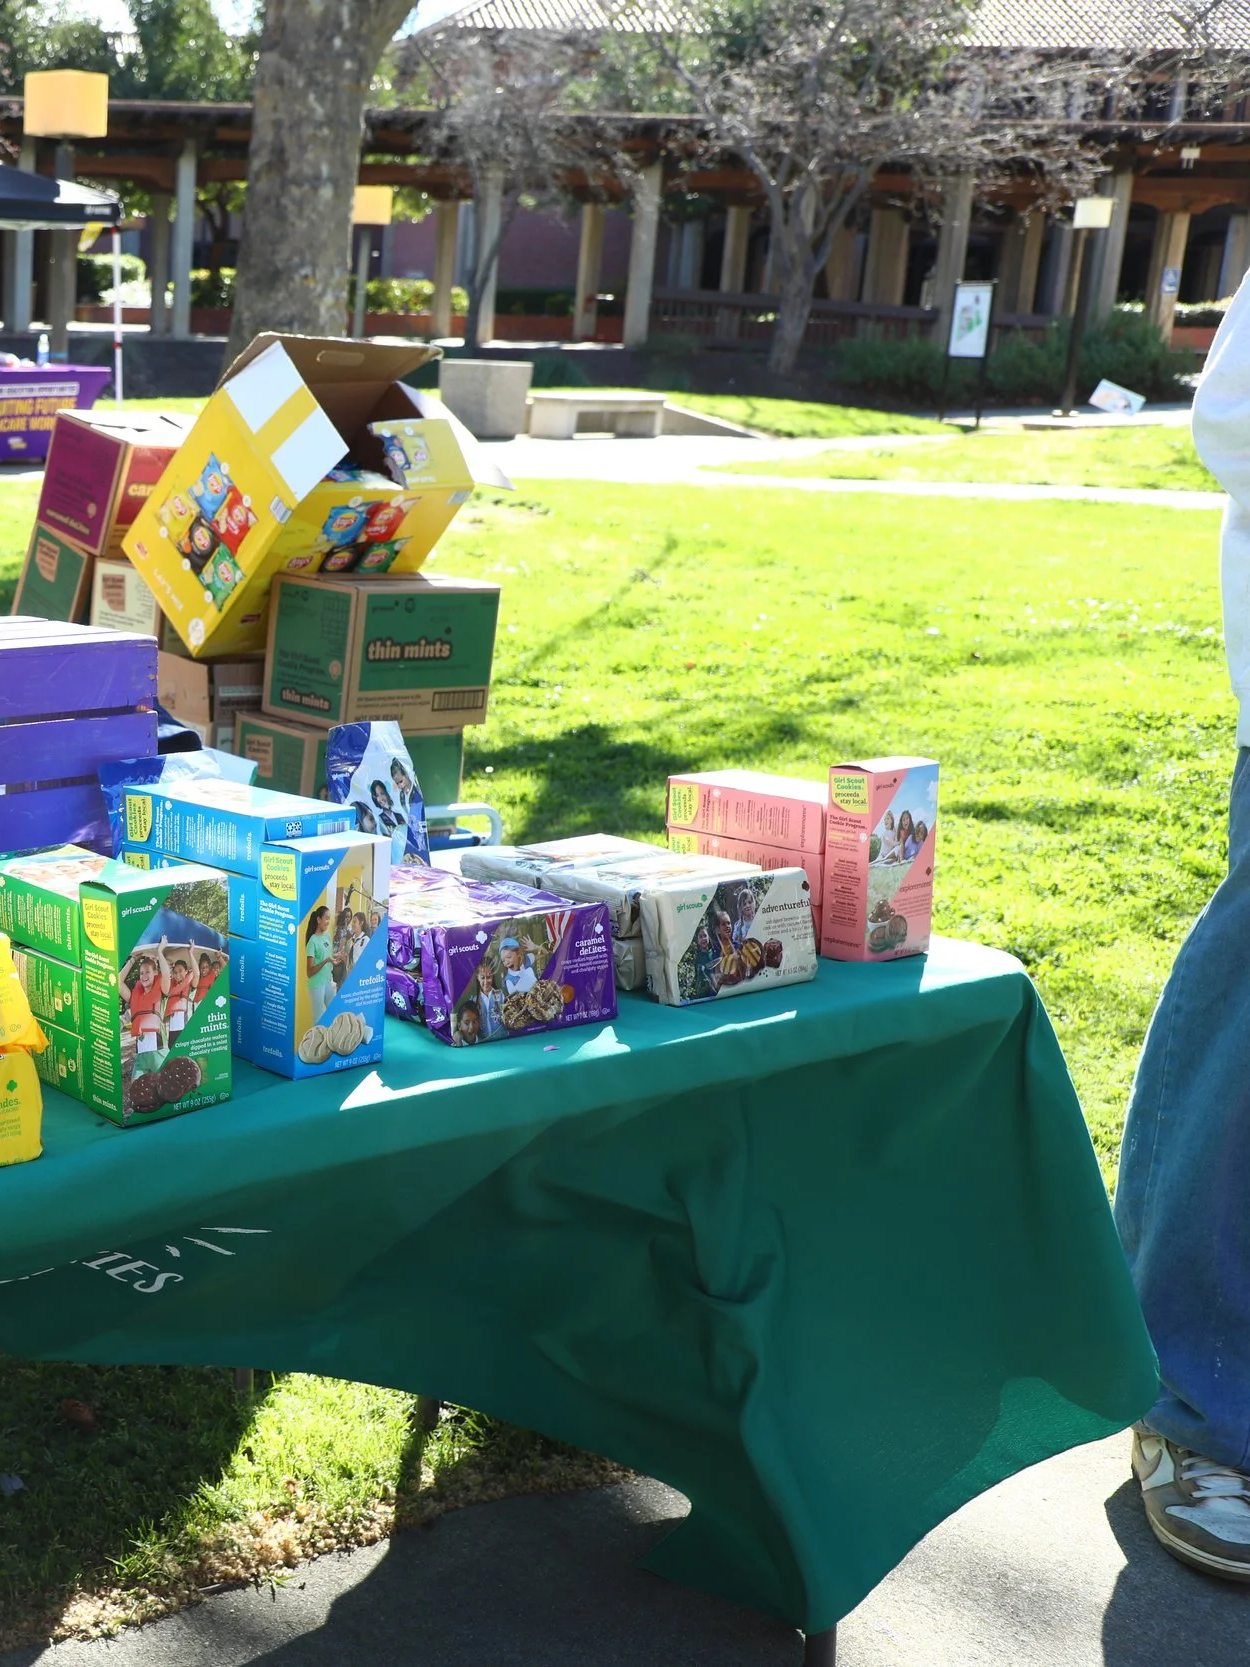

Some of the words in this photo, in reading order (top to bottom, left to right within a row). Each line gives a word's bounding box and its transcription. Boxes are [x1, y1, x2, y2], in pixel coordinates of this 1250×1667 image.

[367, 640, 401, 660] thin
[403, 639, 451, 659] mints
[281, 690, 300, 702] thin
[301, 693, 330, 710] mints
[833, 777, 845, 785] Girl
[846, 777, 865, 785] Scout
[848, 817, 862, 825] Scout
[263, 856, 275, 864] Girl
[275, 857, 293, 865] Scout
[304, 865, 314, 874] girl
[314, 864, 331, 872] scouts
[265, 873, 288, 882] proceeds
[269, 881, 280, 890] stay
[121, 907, 132, 918] girl
[132, 904, 152, 914] scouts
[676, 904, 686, 913] girl
[686, 902, 703, 911] scouts
[575, 935, 605, 948] caramel
[448, 945, 459, 957] girl
[458, 943, 479, 952] scouts
[207, 1012, 227, 1023] thin
[175, 1040, 190, 1048] Crispy
[190, 1036, 212, 1045] chocolate
[190, 1043, 207, 1051] dipped
[92, 1094, 102, 1104] thin
[173, 1102, 182, 1111] NET
[182, 1101, 190, 1109] WT
[190, 1099, 194, 1107] 9
